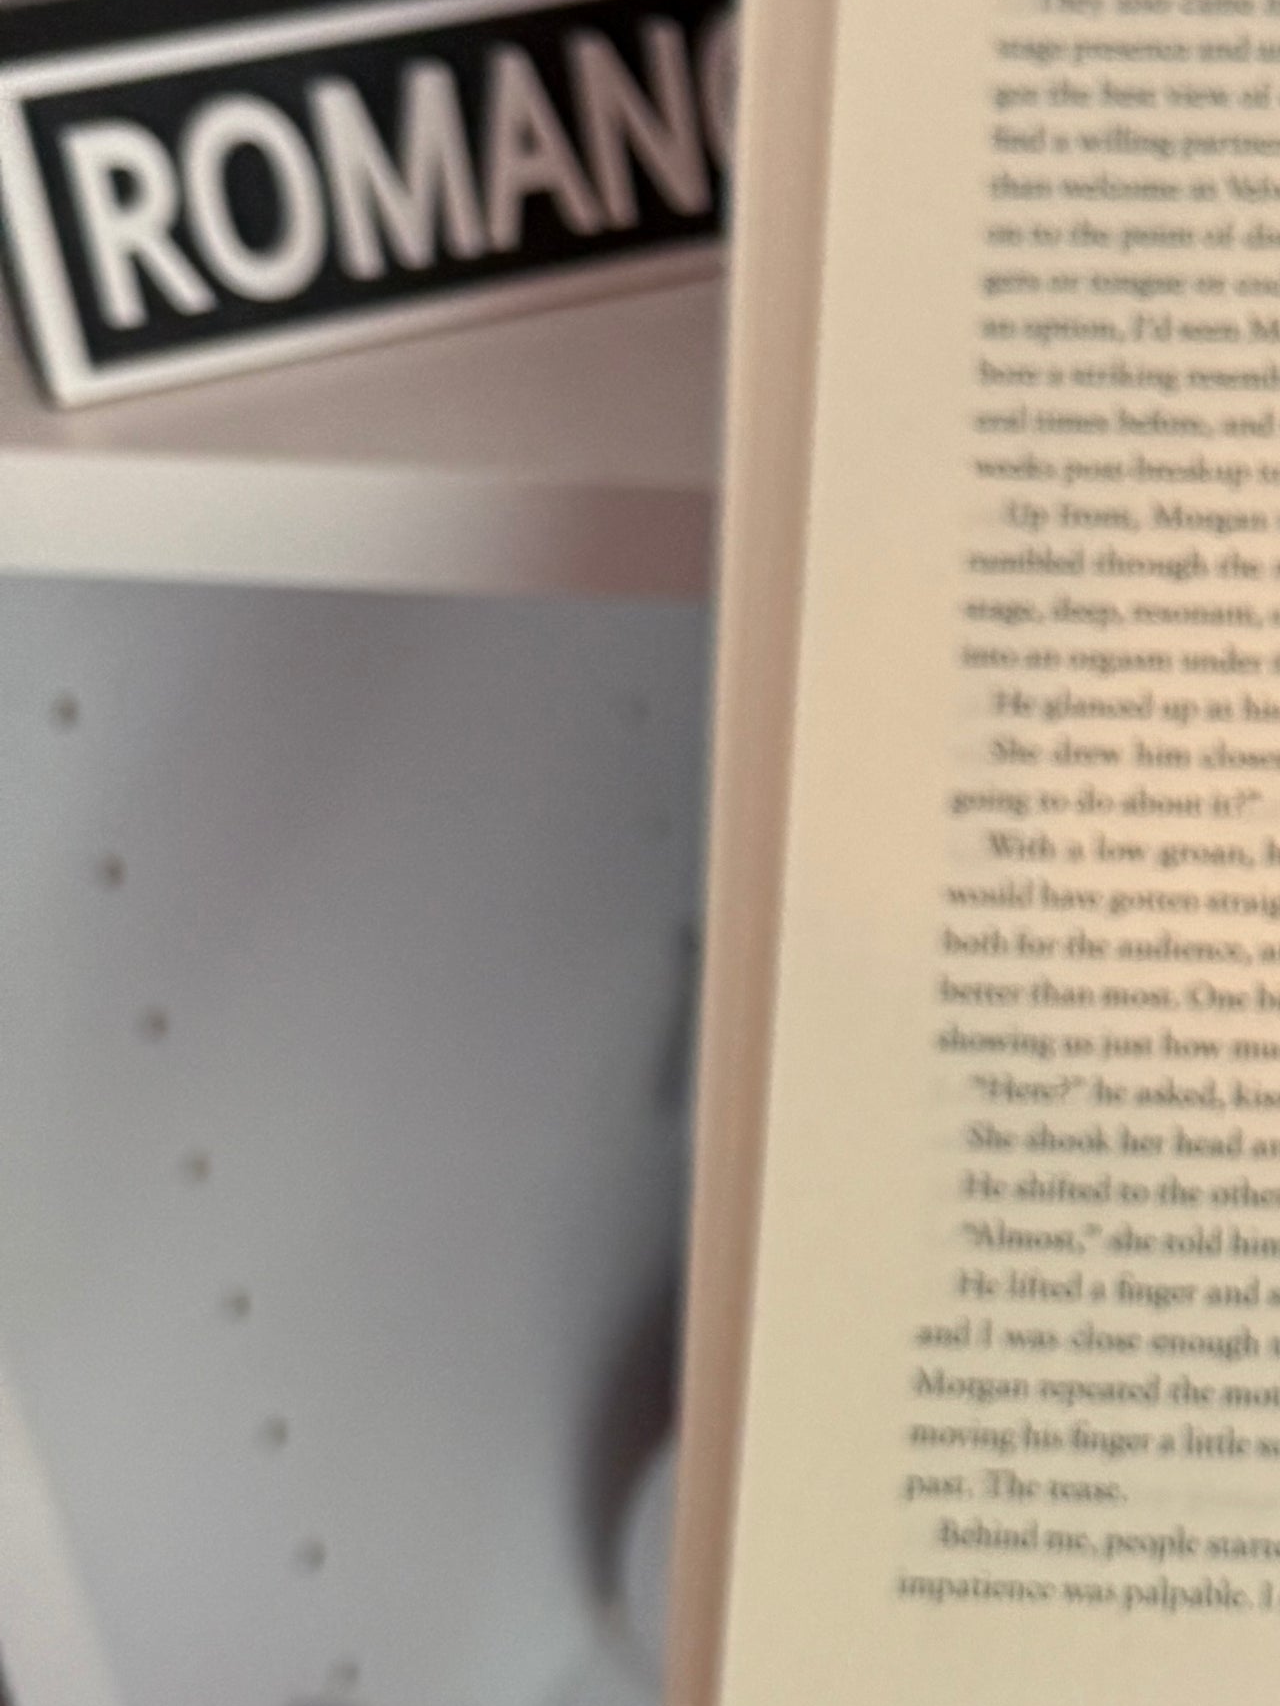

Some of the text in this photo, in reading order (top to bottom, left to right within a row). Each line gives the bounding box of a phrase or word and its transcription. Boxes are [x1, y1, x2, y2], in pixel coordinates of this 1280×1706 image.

[966, 1118, 1018, 1152] She
[1021, 1119, 1112, 1155] shook
[1115, 1122, 1166, 1156] her
[1169, 1123, 1247, 1158] head
[964, 1167, 1008, 1201] He
[1011, 1168, 1114, 1203] shifted
[1117, 1174, 1151, 1203] to
[1154, 1171, 1204, 1205] the
[1105, 1220, 1157, 1255] she
[1160, 1222, 1225, 1257] told
[917, 1314, 974, 1349] and
[1001, 1325, 1060, 1351] was
[1066, 1319, 1142, 1354] close
[1148, 1321, 1260, 1366] enough
[896, 1568, 1055, 1610] impatience
[1062, 1578, 1117, 1604] was
